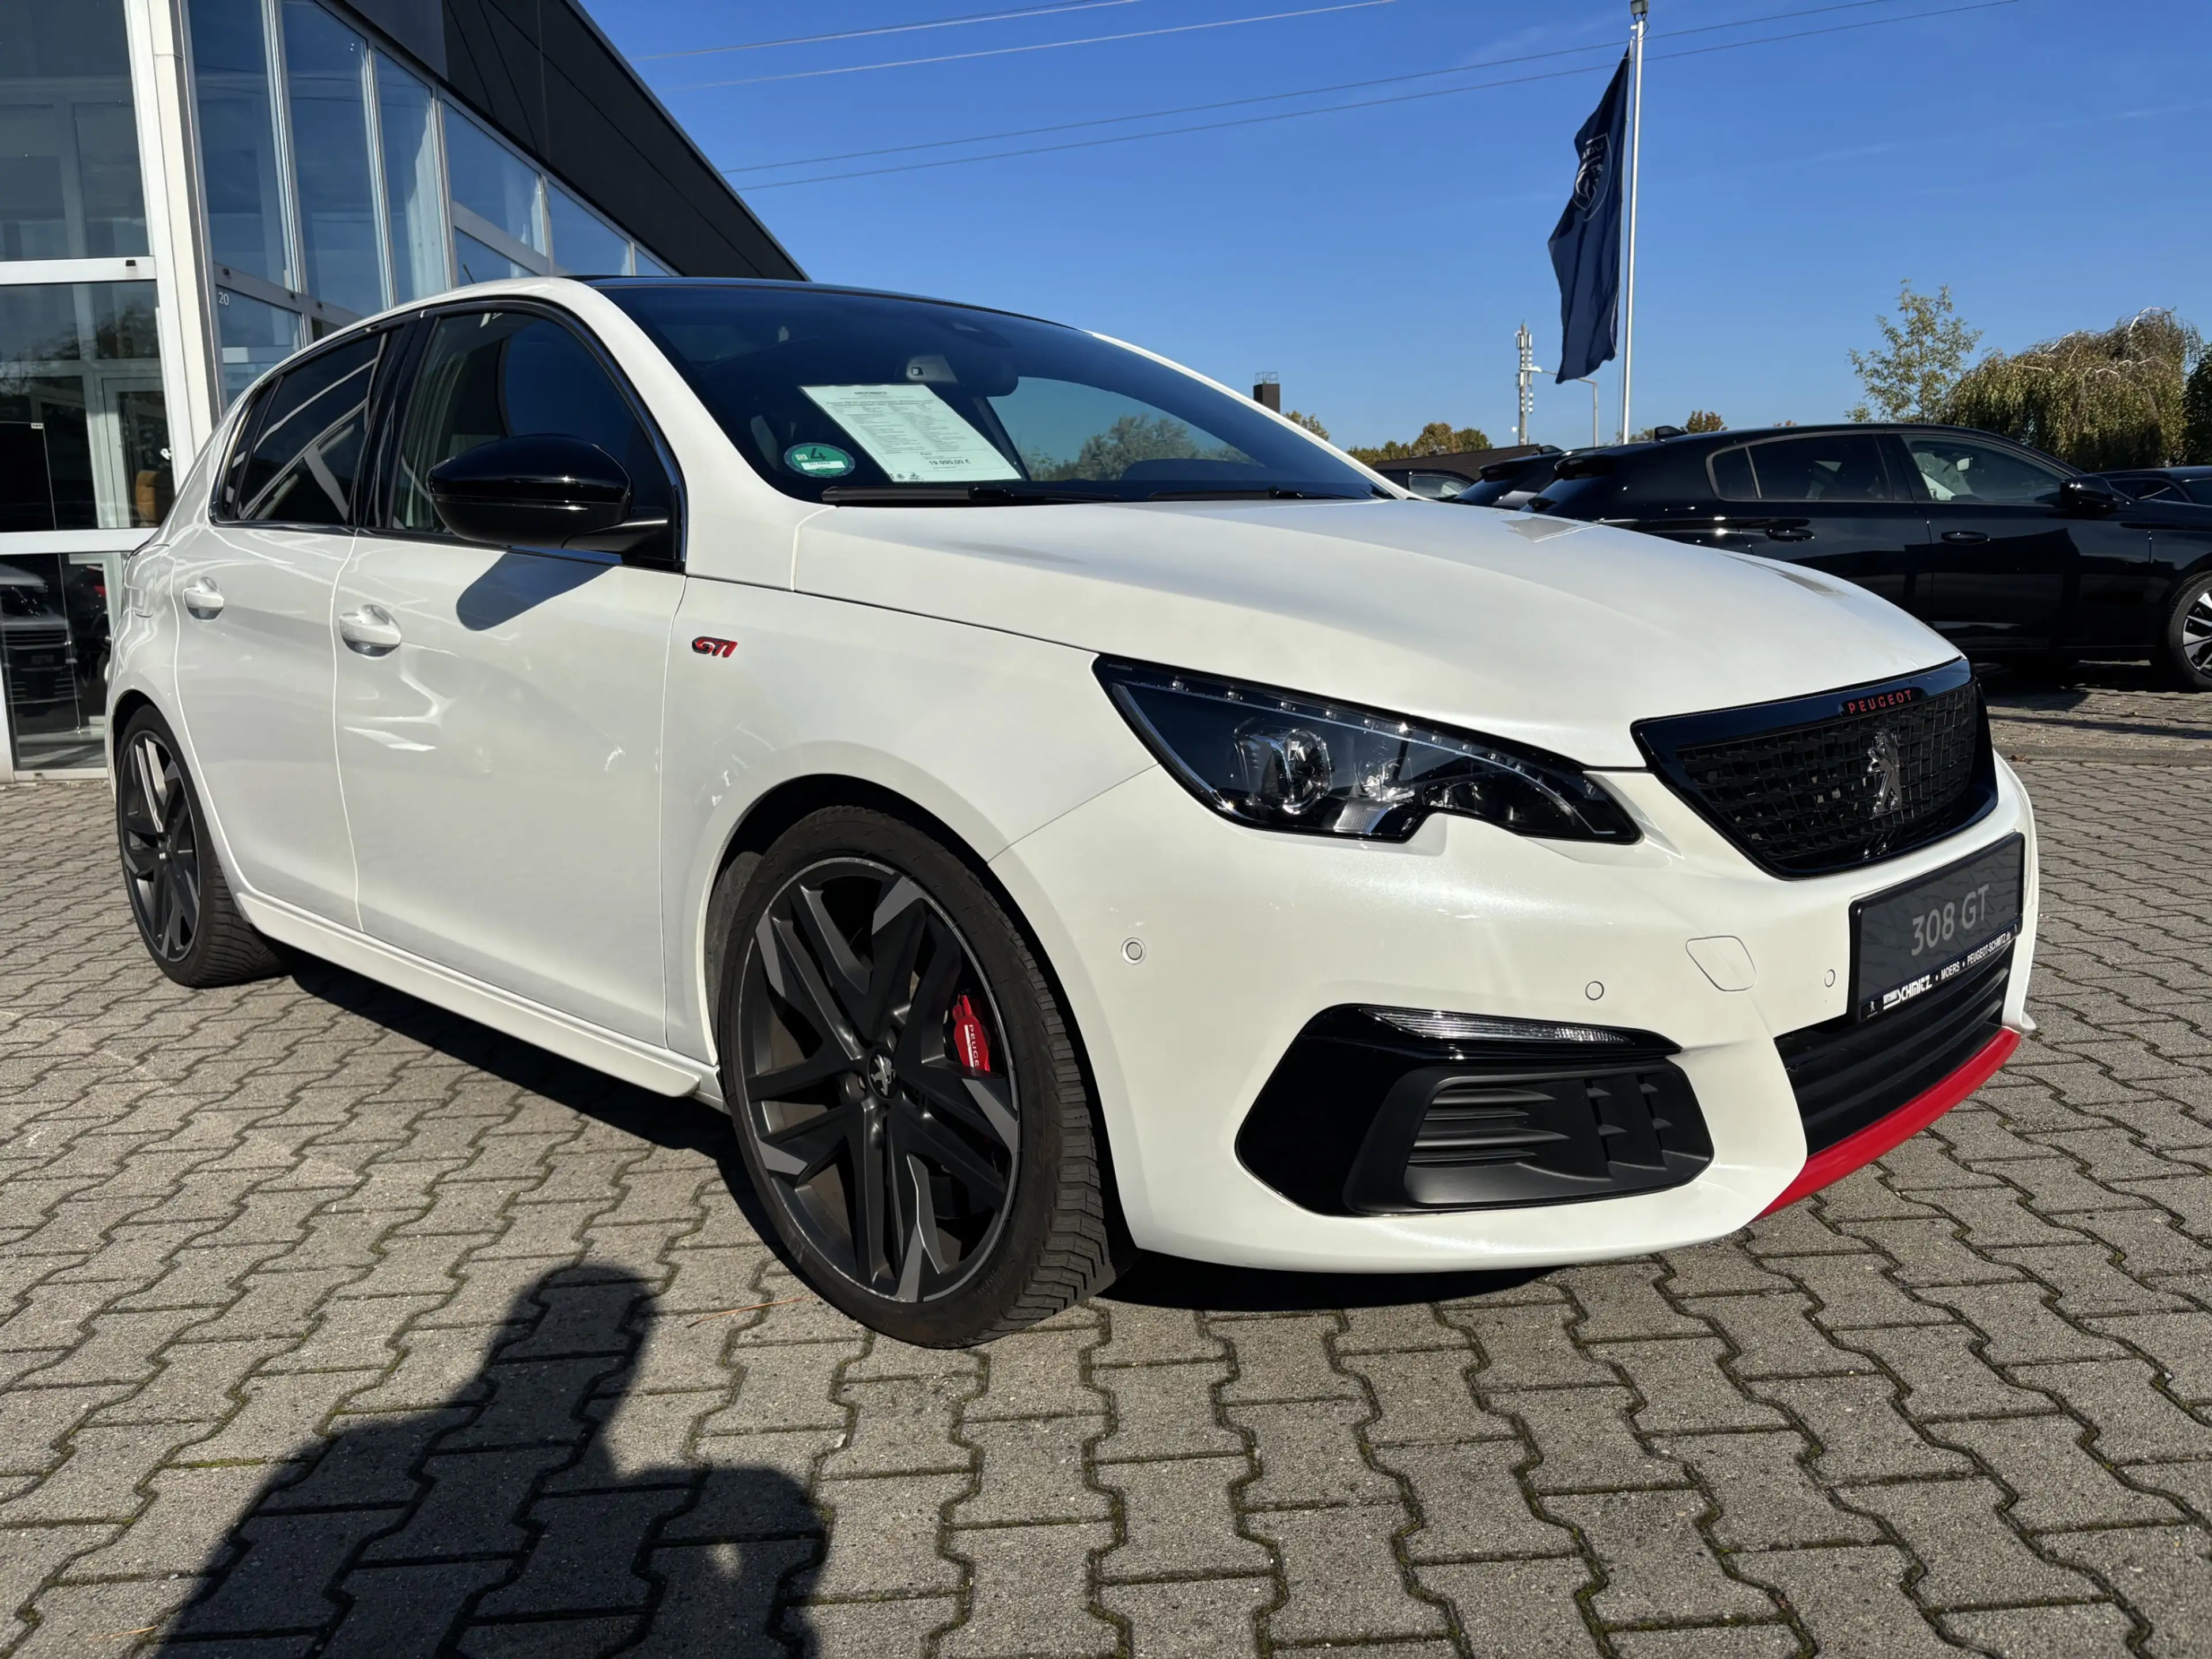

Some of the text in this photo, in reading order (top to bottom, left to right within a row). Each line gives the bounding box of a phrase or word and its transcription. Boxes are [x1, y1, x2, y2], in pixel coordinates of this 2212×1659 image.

[219, 292, 229, 305] 20
[810, 448, 826, 460] 4
[1847, 690, 1911, 714] PEUGEOT
[1911, 884, 1989, 956] 308 GT
[1883, 974, 1933, 1010] SCHMITZ
[1941, 961, 1960, 980] MOERS
[969, 1024, 979, 1069] PEUGE
